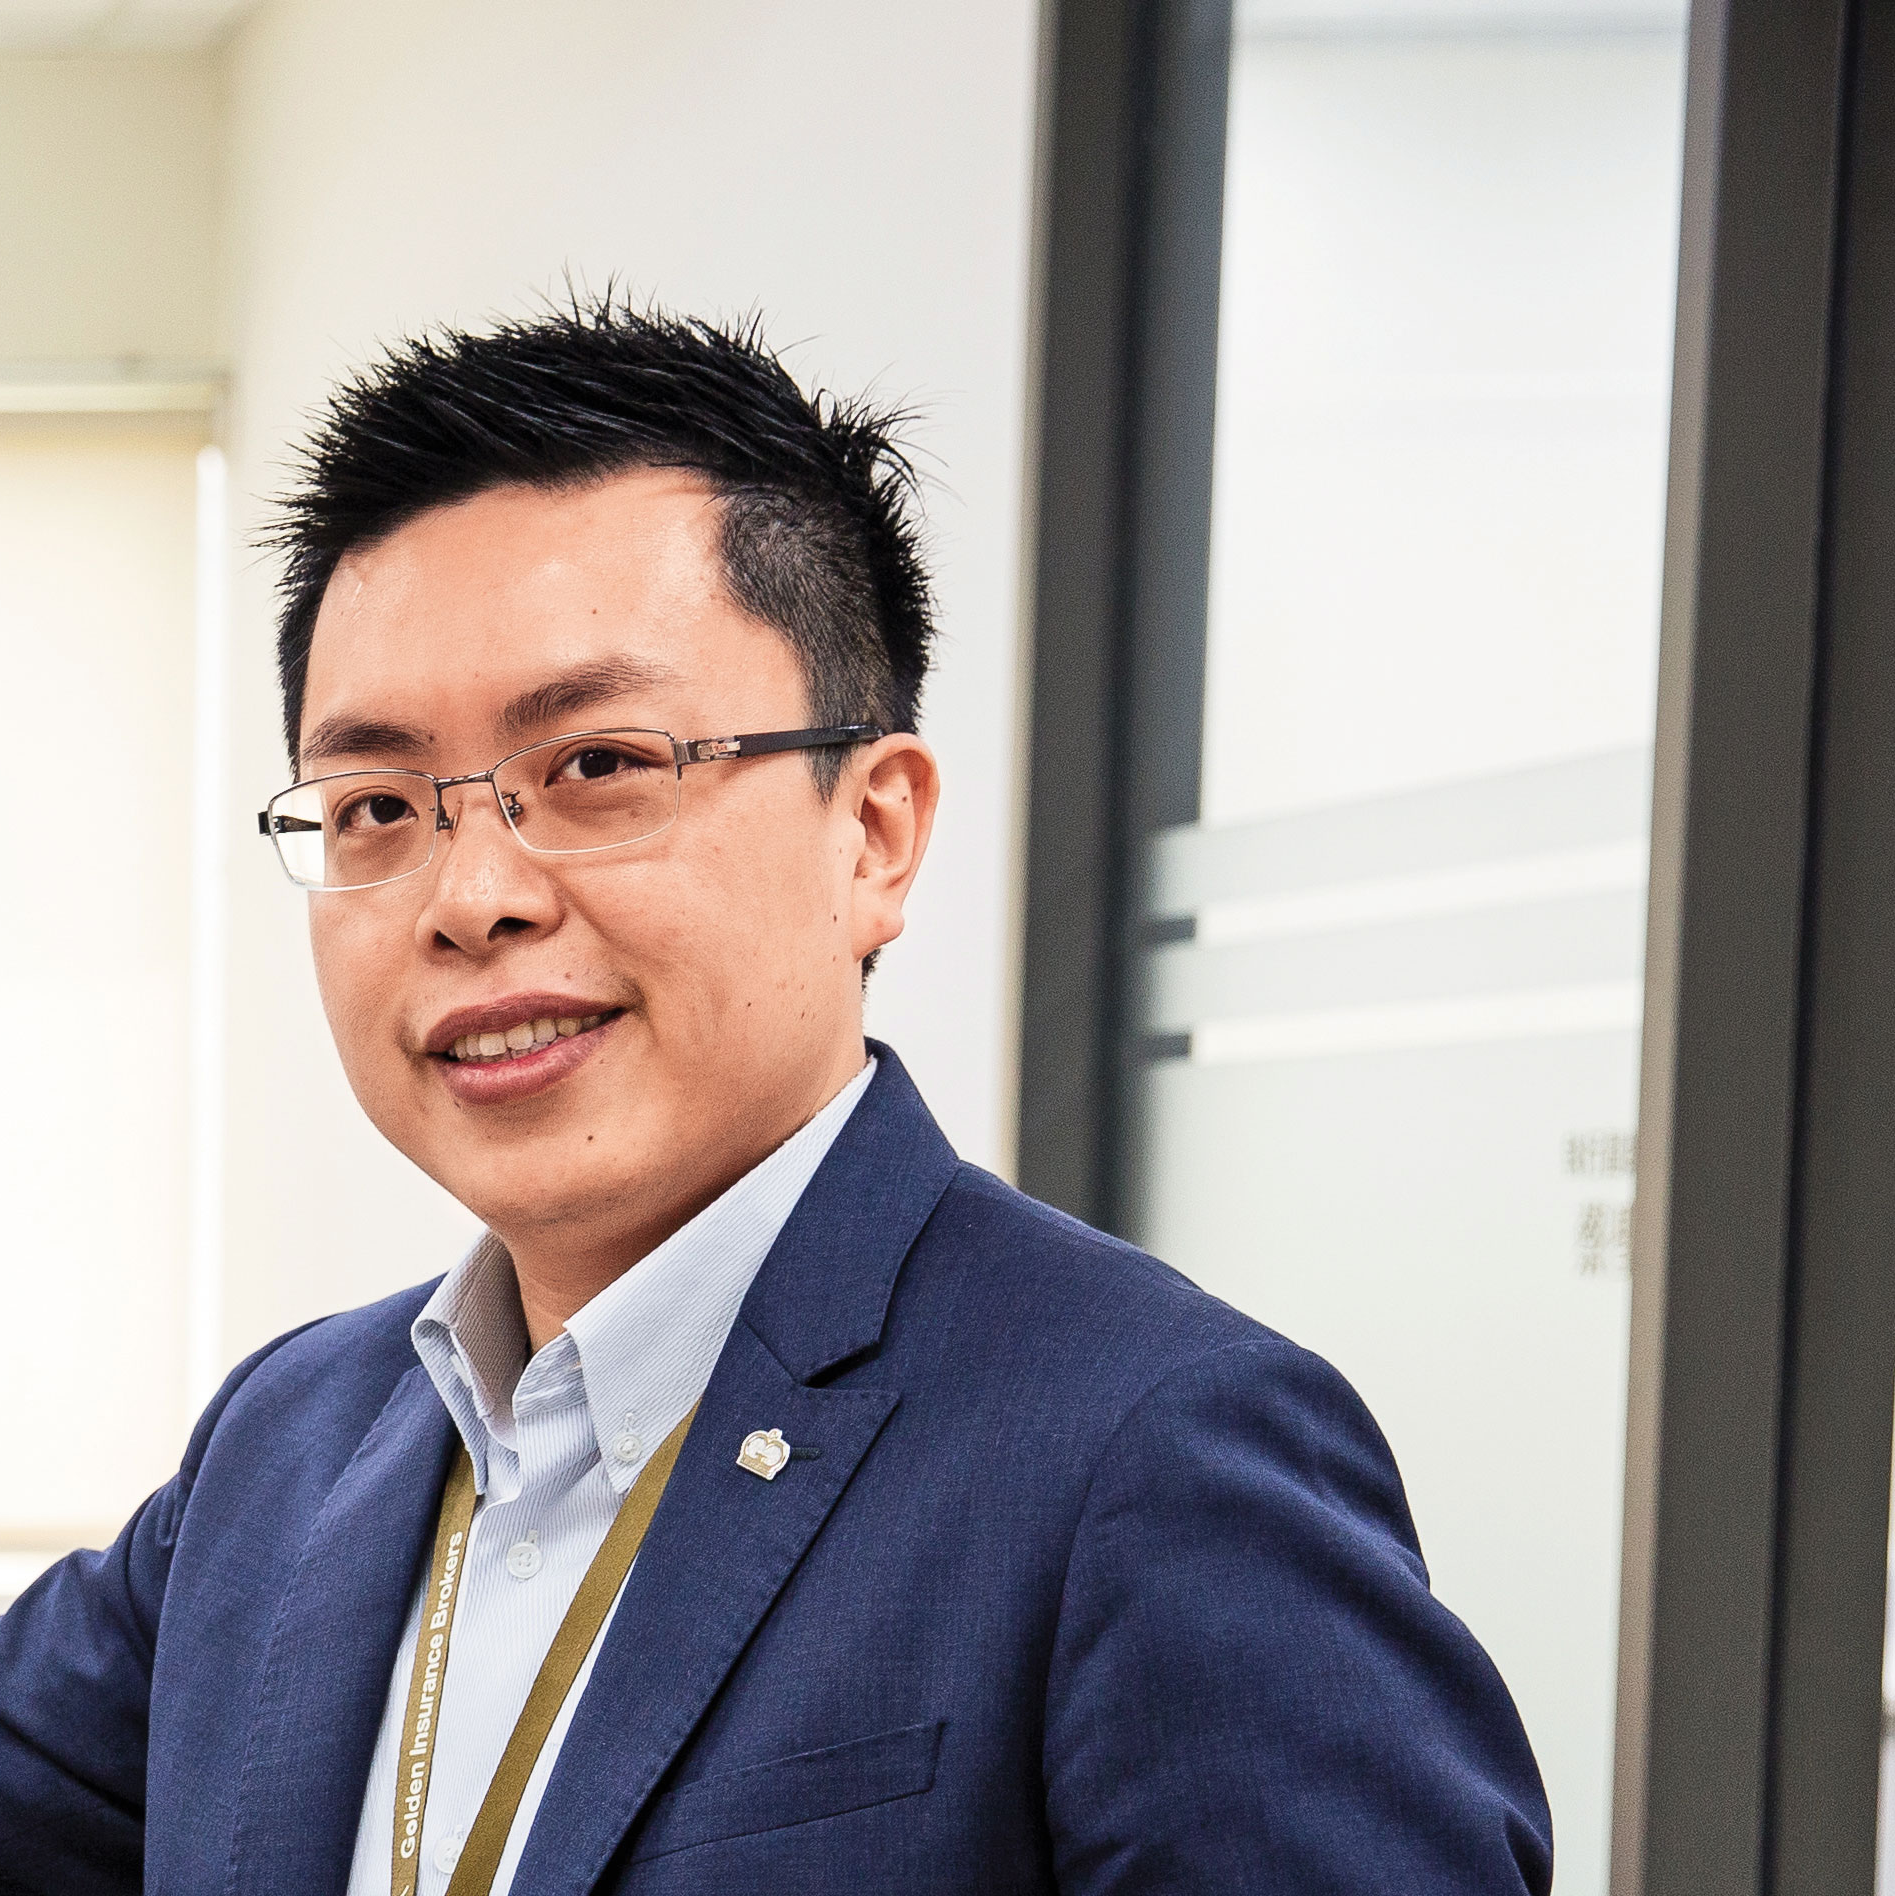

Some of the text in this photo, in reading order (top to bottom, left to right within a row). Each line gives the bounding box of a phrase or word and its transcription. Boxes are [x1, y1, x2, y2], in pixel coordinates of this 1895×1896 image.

[398, 1530, 464, 1860] Golden Insurance Brokers
